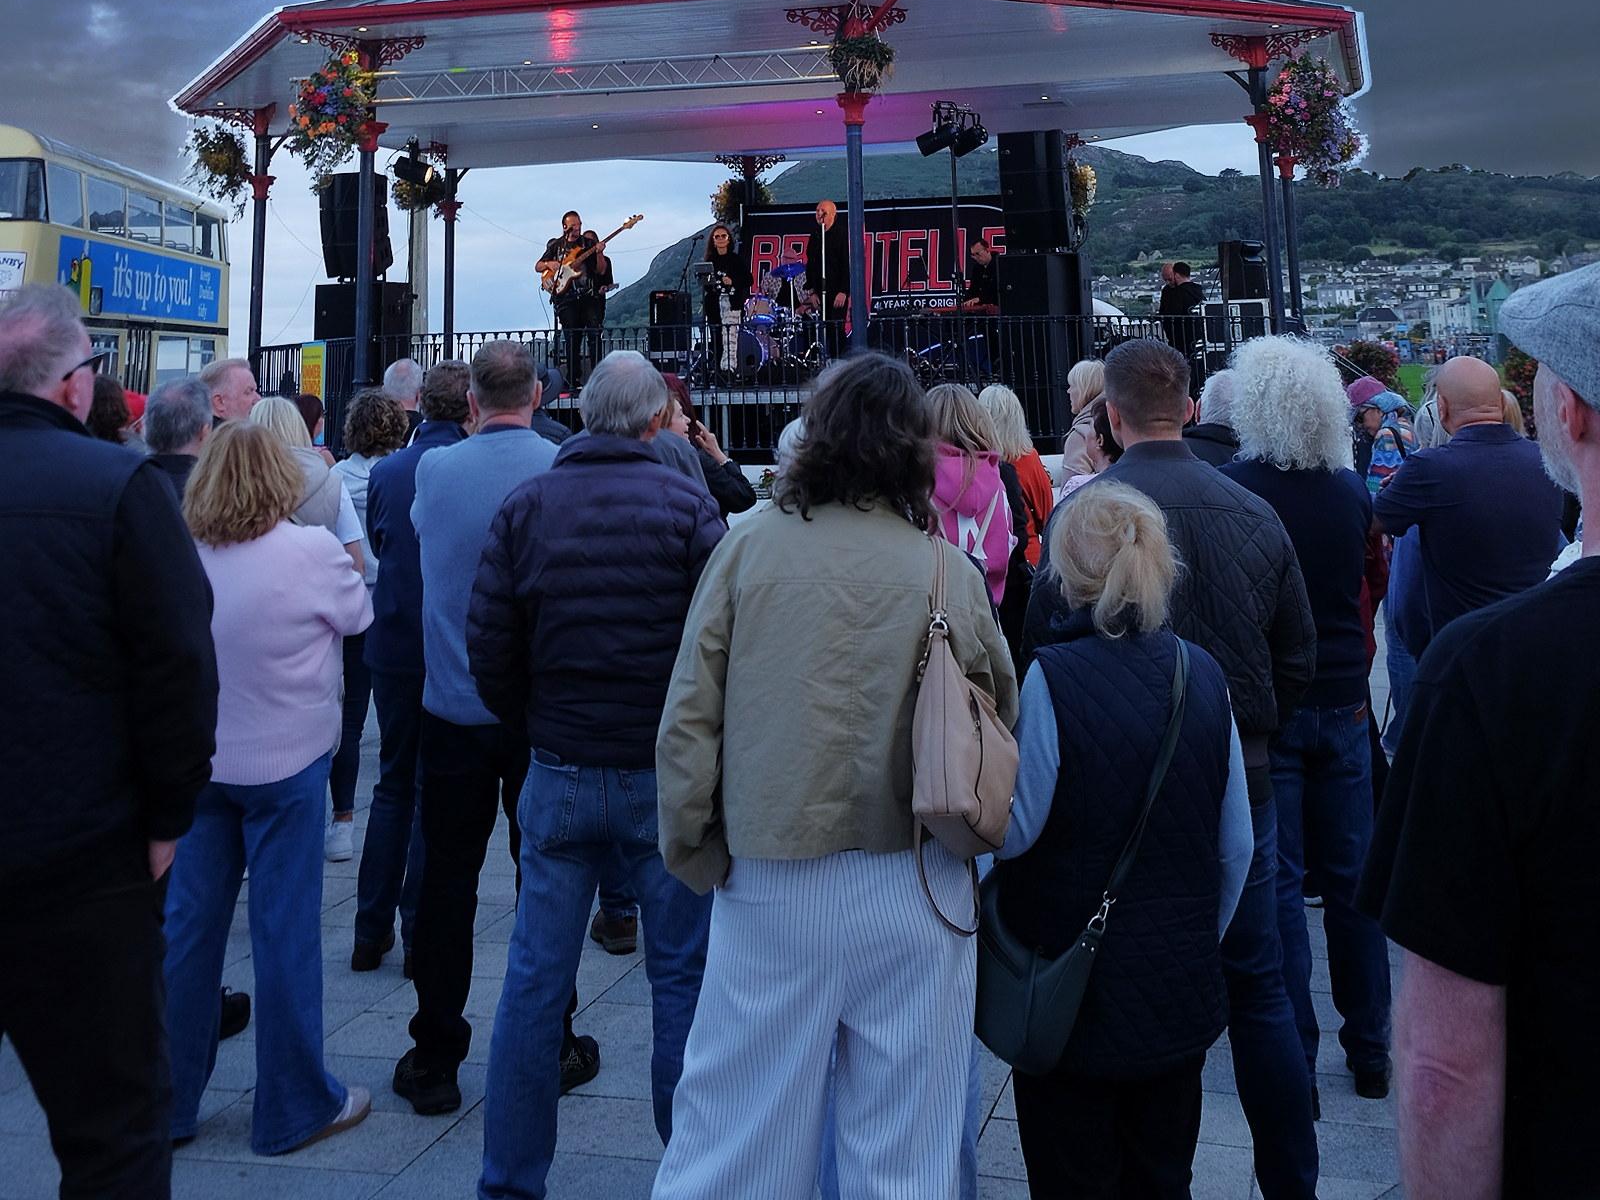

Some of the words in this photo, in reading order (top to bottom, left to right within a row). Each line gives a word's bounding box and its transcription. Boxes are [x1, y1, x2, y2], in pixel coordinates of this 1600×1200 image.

[112, 251, 133, 298] it's
[135, 270, 152, 311] up
[154, 264, 167, 303] to
[166, 267, 193, 313] you!
